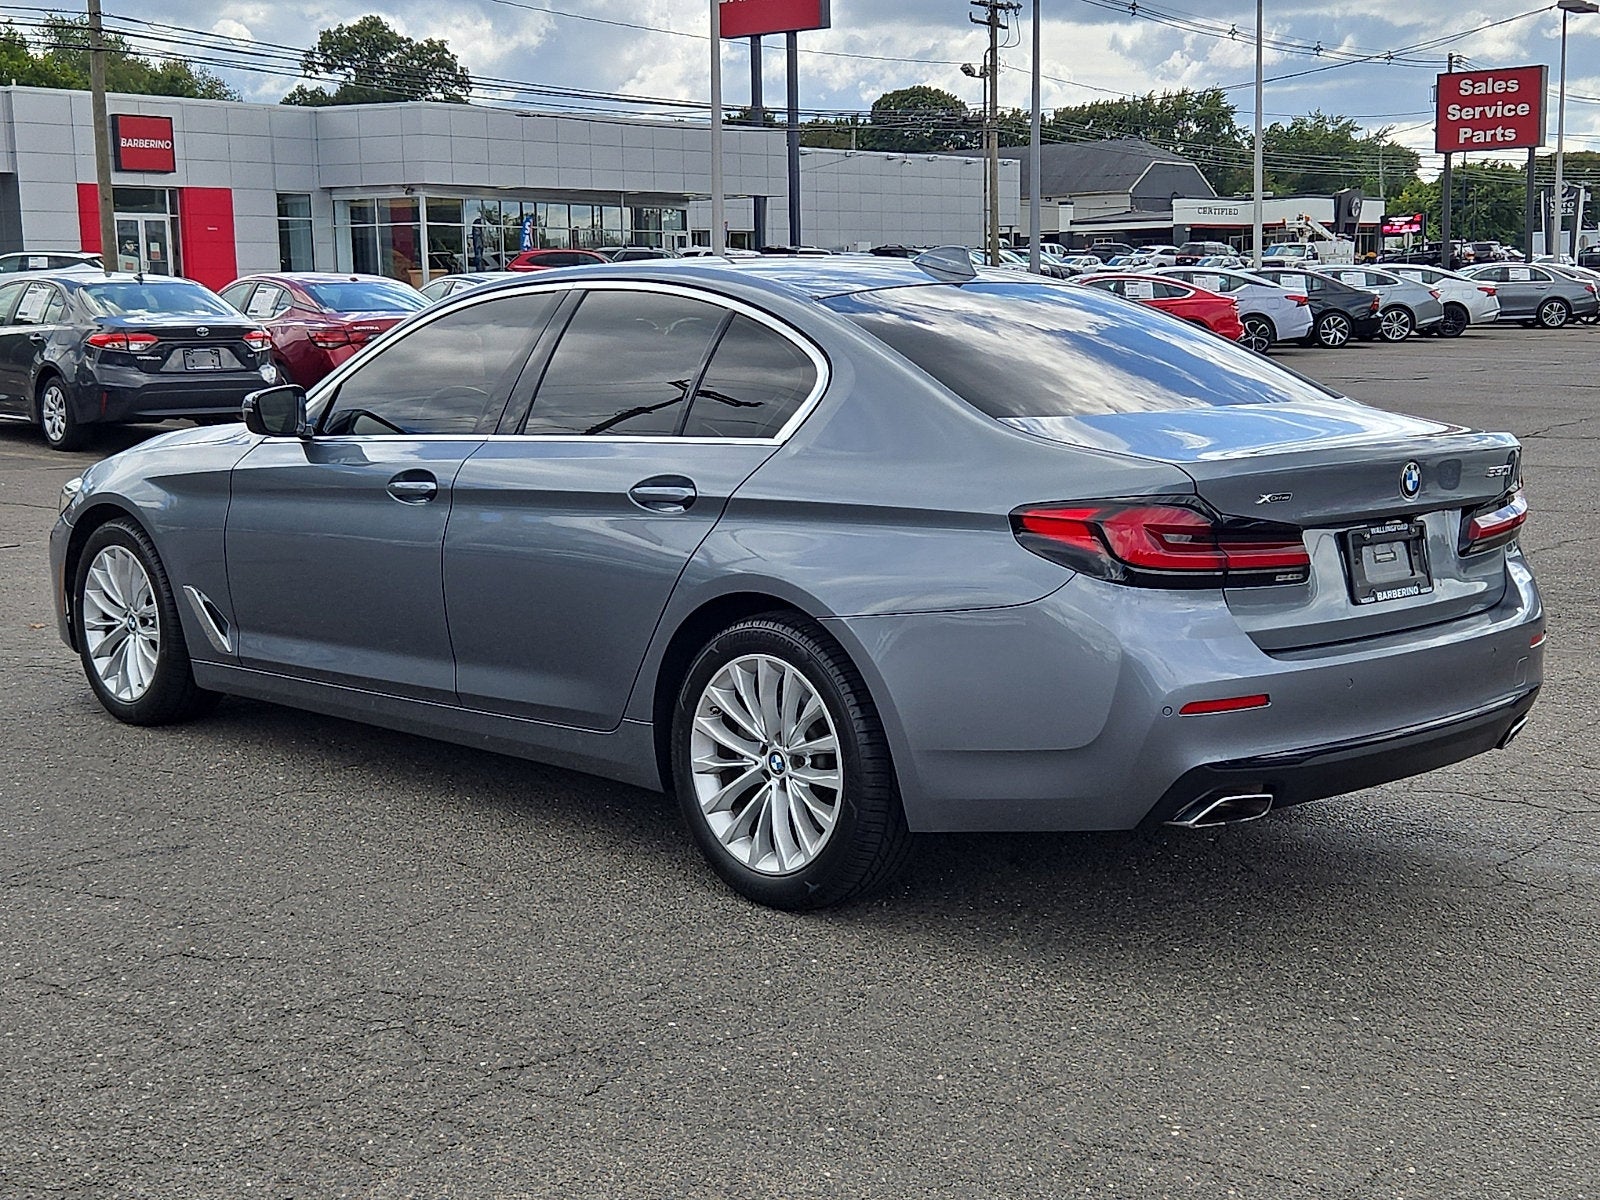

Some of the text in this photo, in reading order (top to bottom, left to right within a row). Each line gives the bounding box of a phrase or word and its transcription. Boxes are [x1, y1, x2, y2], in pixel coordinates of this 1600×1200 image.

[1459, 77, 1519, 96] Sales
[1446, 101, 1530, 121] Service
[1458, 126, 1516, 144] Parts
[120, 138, 172, 150] BARBERINO
[1197, 206, 1239, 216] CERTIFIED
[1376, 585, 1419, 602] BARBERINO
